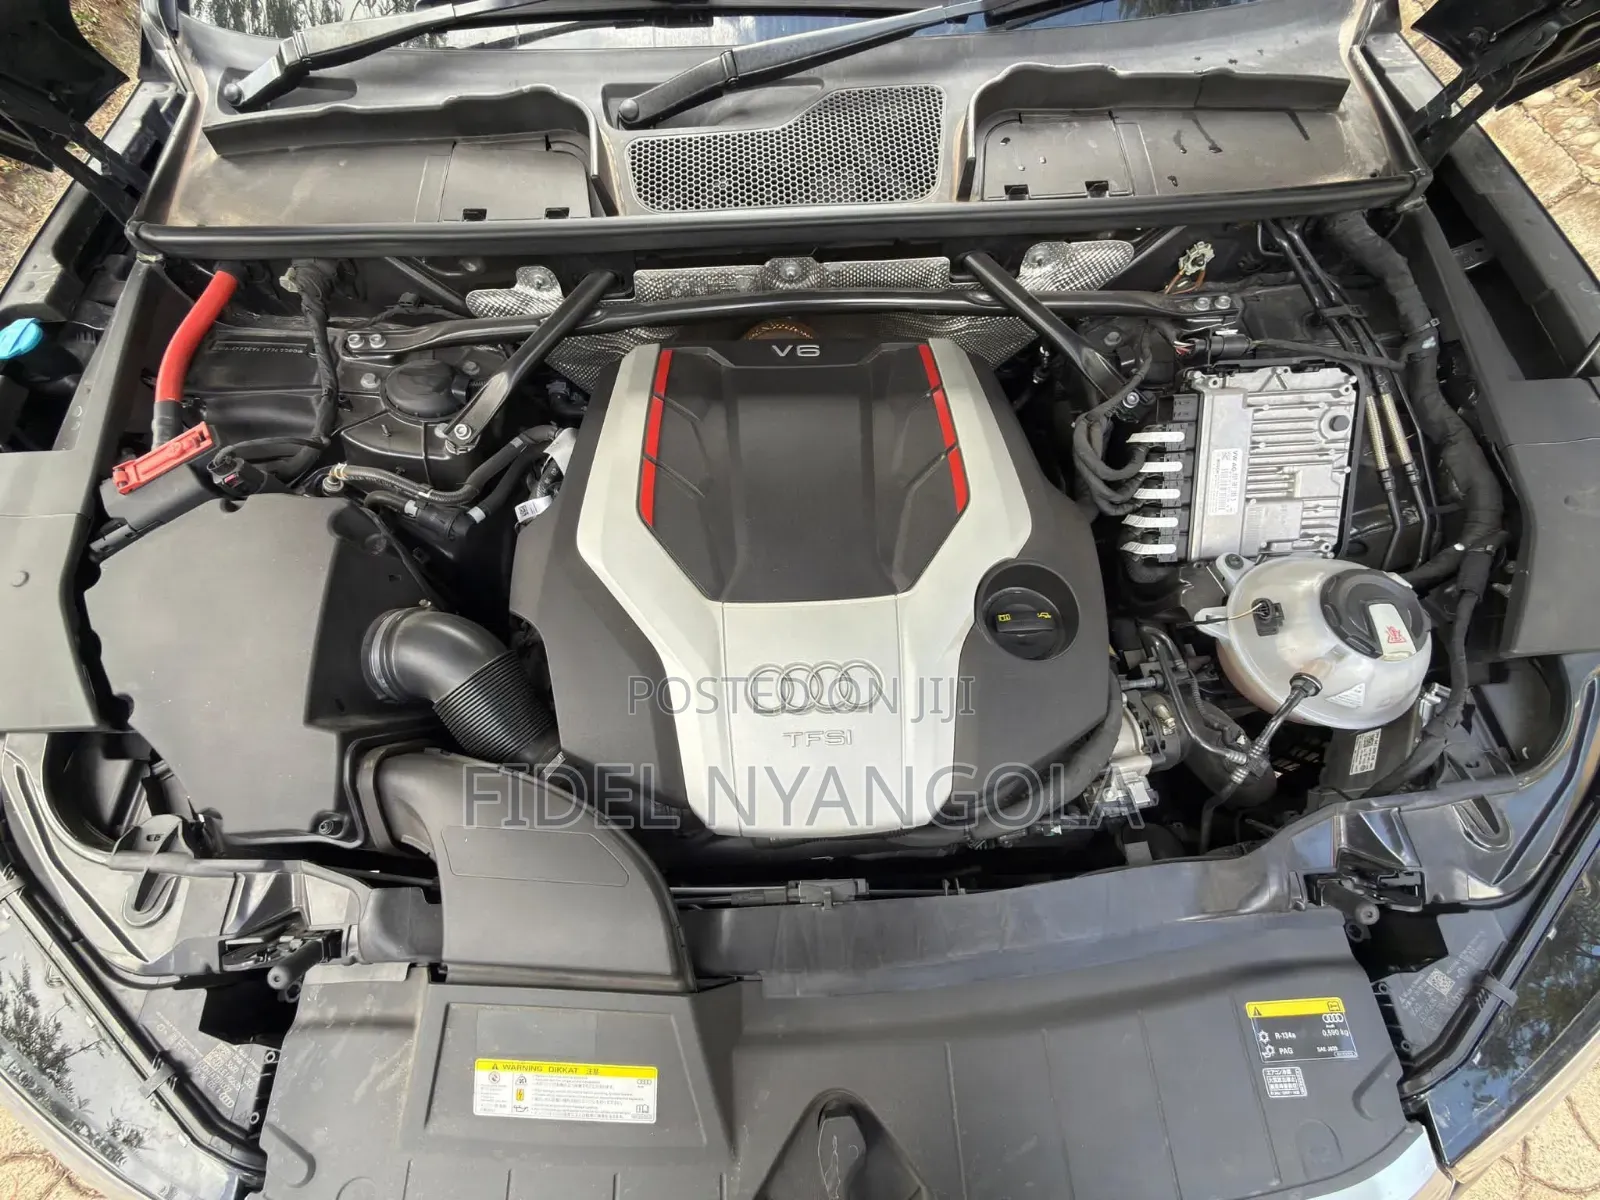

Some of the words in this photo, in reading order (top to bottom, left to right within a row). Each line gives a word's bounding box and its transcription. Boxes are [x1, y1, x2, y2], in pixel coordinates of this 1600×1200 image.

[771, 344, 820, 357] V6
[782, 729, 852, 748] TFSI
[1275, 1031, 1297, 1040] R-134a
[1278, 1047, 1294, 1055] PAG
[502, 1064, 543, 1072] WARNING
